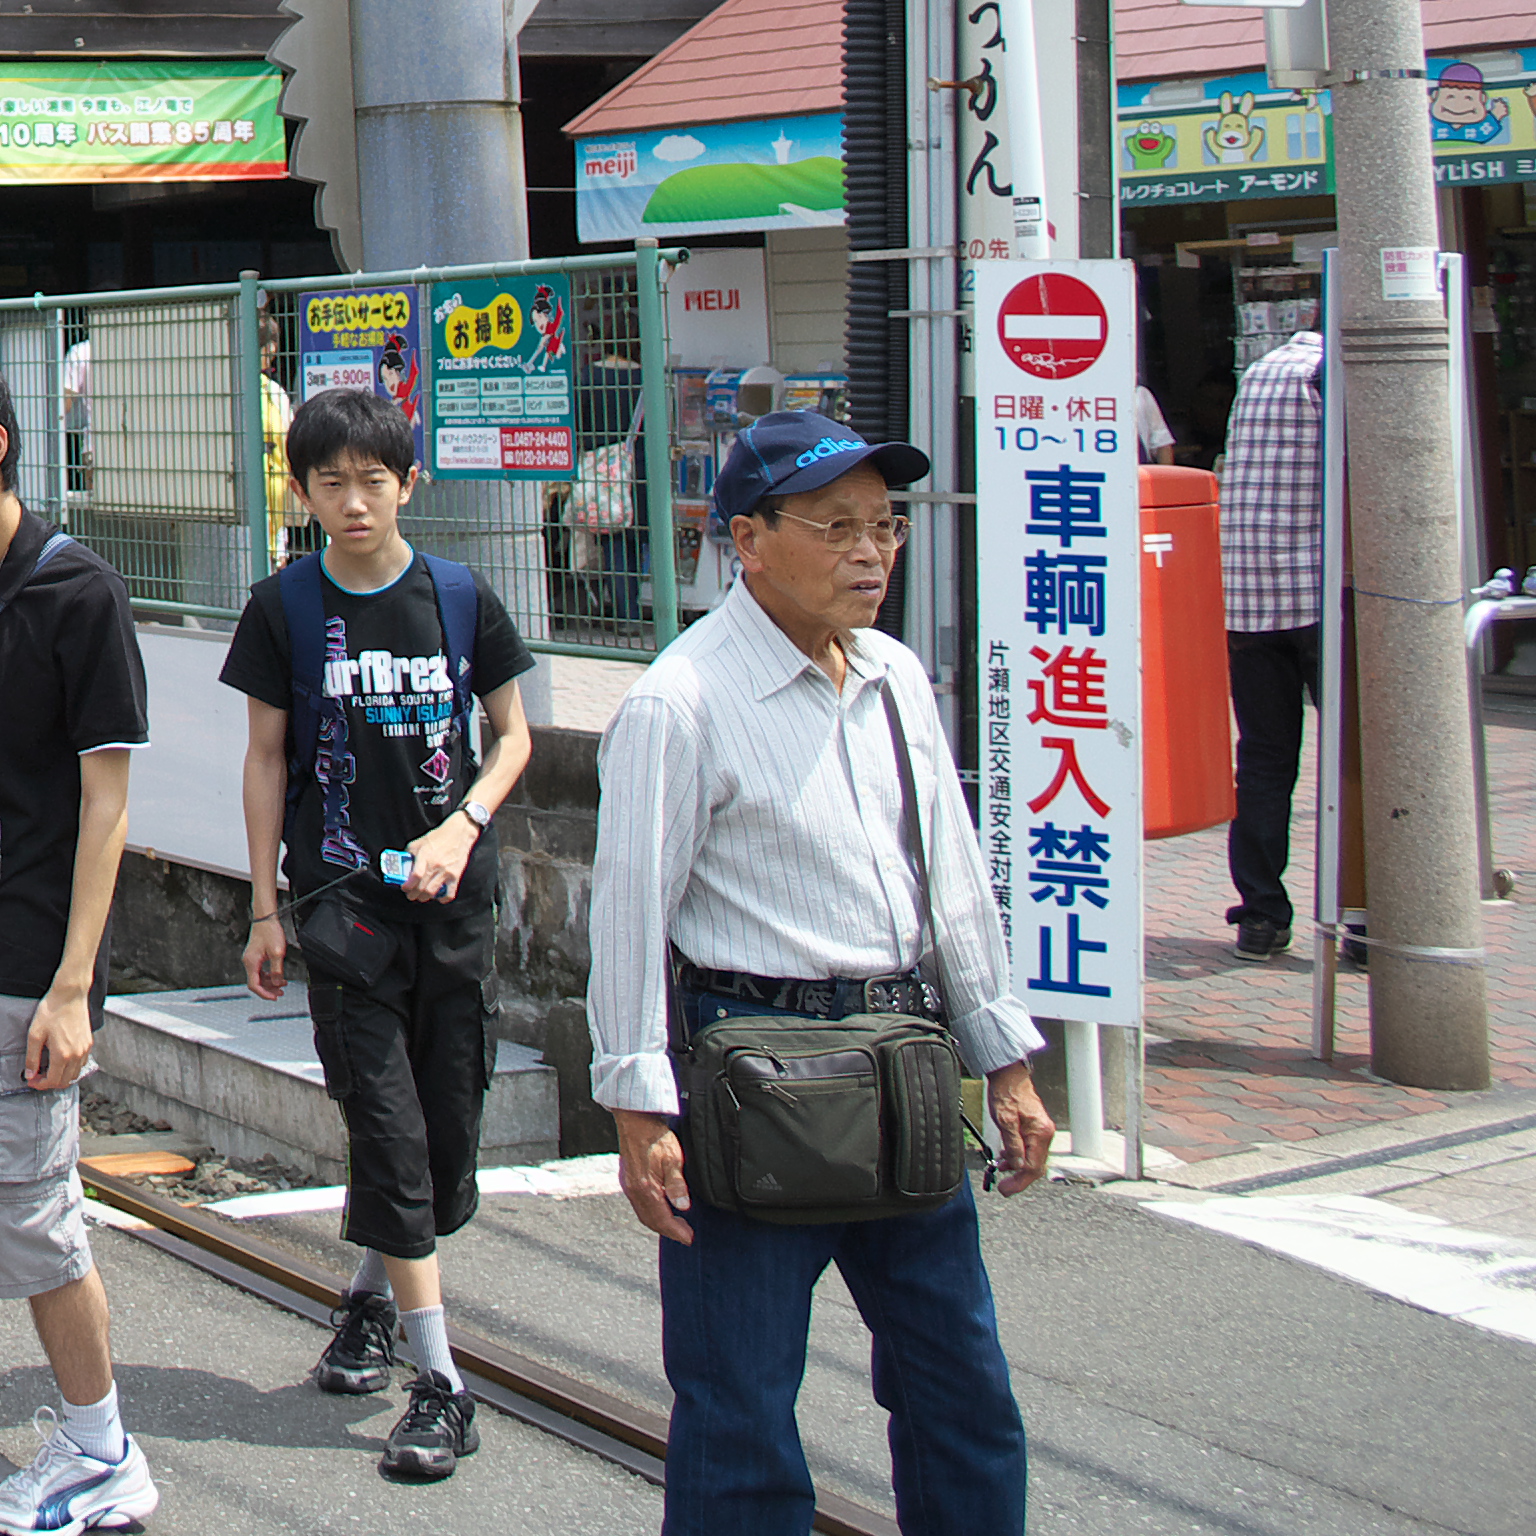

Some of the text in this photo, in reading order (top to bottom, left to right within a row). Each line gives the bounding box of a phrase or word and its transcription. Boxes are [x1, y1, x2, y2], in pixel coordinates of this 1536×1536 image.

[87, 119, 256, 146] バス開業85周年
[585, 150, 636, 179] meiji
[1239, 169, 1319, 193] アーモンド
[684, 288, 741, 312] MEIJI
[453, 302, 515, 350] お掃除
[993, 395, 1118, 422] 日曜・休日
[352, 695, 396, 707] FLORIDA
[399, 694, 435, 706] SOUTH
[366, 706, 412, 723] SUNNY
